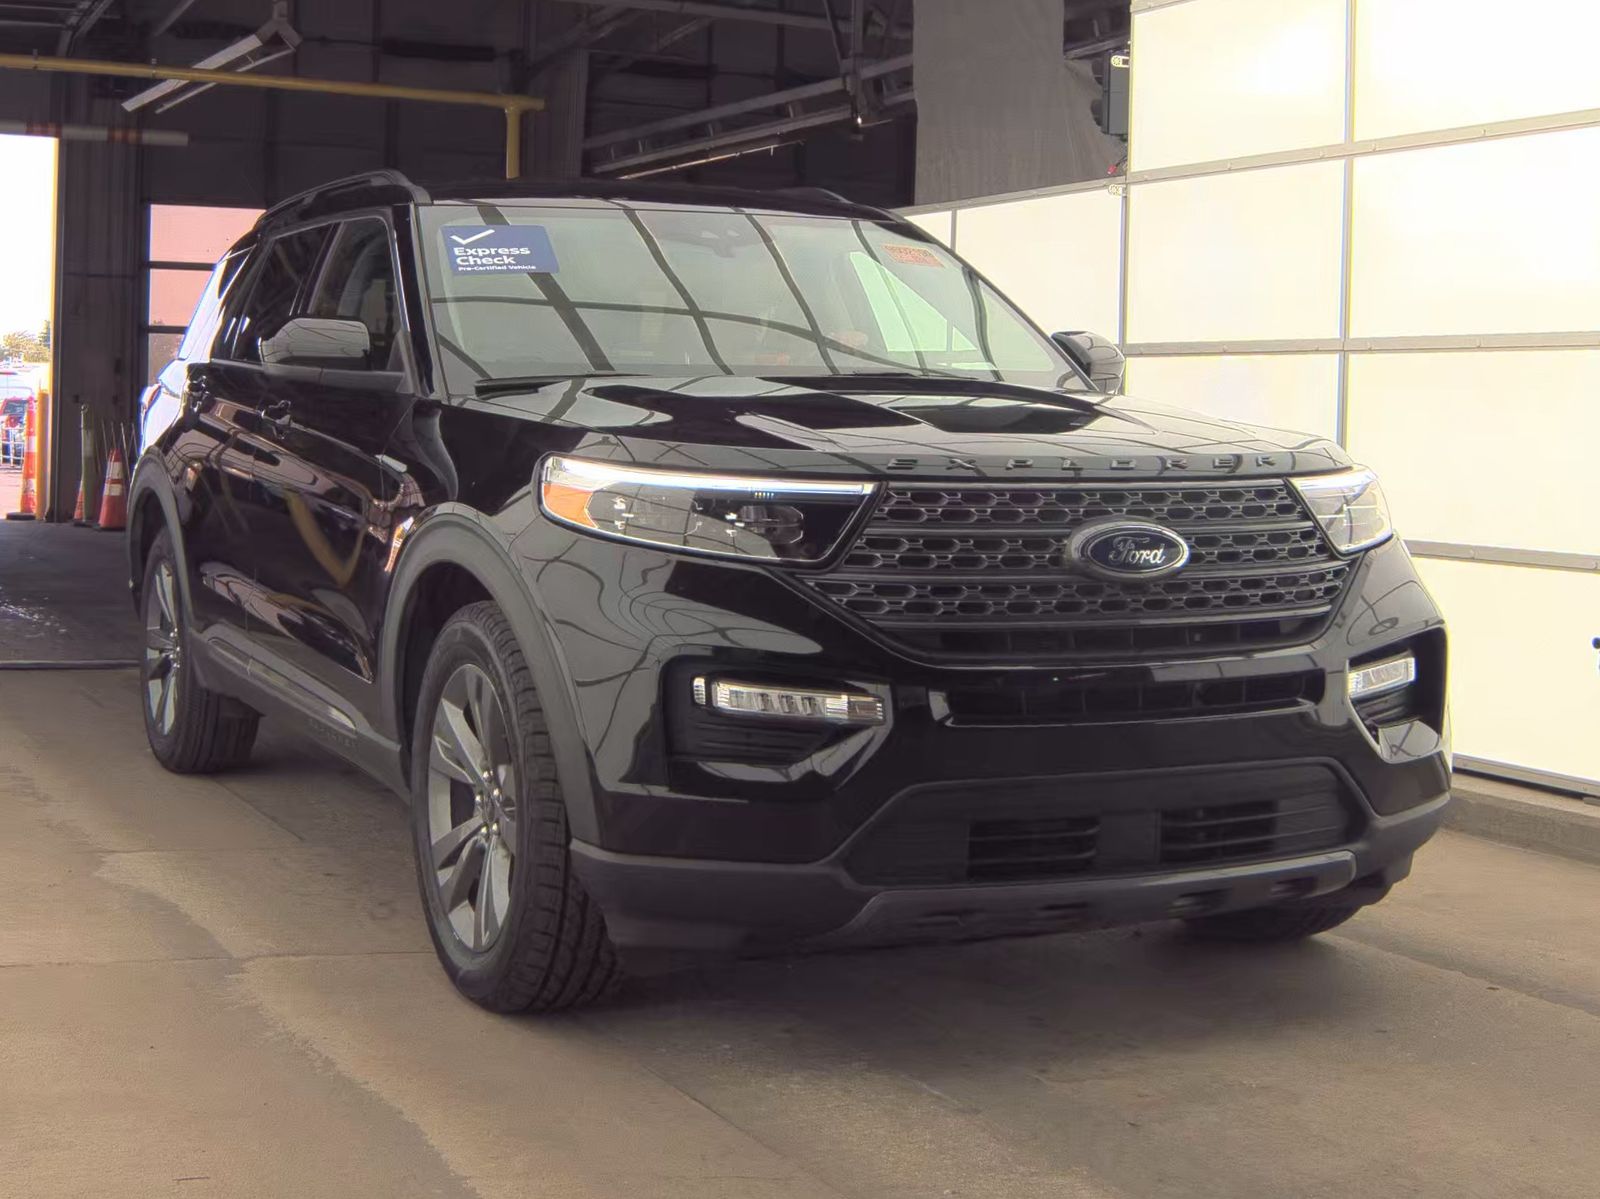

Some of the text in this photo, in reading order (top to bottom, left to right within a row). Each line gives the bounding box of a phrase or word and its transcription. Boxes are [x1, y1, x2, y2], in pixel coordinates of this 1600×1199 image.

[453, 247, 531, 257] Express
[455, 255, 517, 265] Check
[886, 454, 1276, 472] EXPLORER
[1108, 536, 1166, 564] Ford
